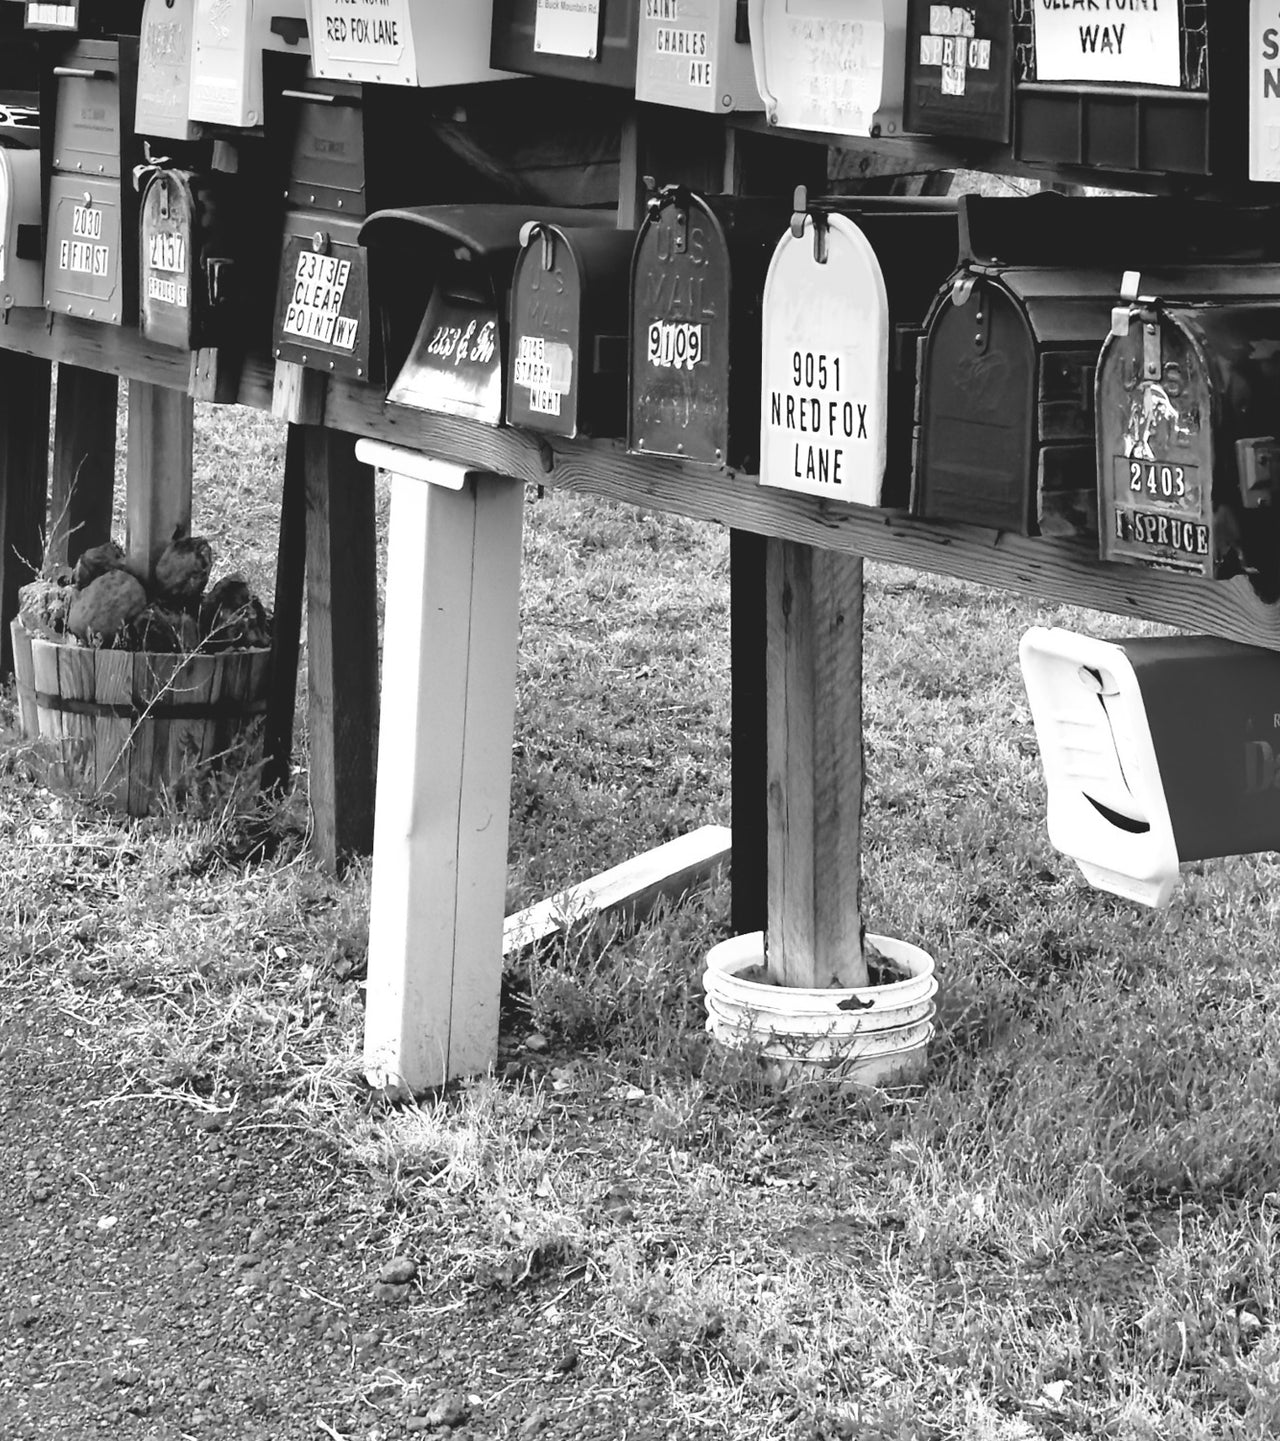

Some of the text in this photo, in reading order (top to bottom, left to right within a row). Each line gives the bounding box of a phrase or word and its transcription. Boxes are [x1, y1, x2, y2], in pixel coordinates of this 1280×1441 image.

[326, 16, 399, 46] RED FOX LANE
[658, 31, 706, 56] CHARLES
[1079, 23, 1125, 54] WAY
[921, 36, 990, 70] SPRUCE
[690, 63, 711, 86] AVE
[74, 209, 101, 237] 2030
[61, 242, 108, 275] E FIRST
[297, 254, 349, 287] 2313 E
[295, 282, 341, 314] CLEAR
[287, 306, 356, 347] POINT WY
[650, 324, 701, 363] 9109
[516, 360, 550, 385] STARRY
[793, 351, 840, 392] 9051
[531, 388, 560, 414] NIGHT
[829, 401, 867, 439] FOX
[795, 442, 843, 485] LANE
[1130, 462, 1185, 497] 2403
[1135, 511, 1209, 556] SPRUCE
